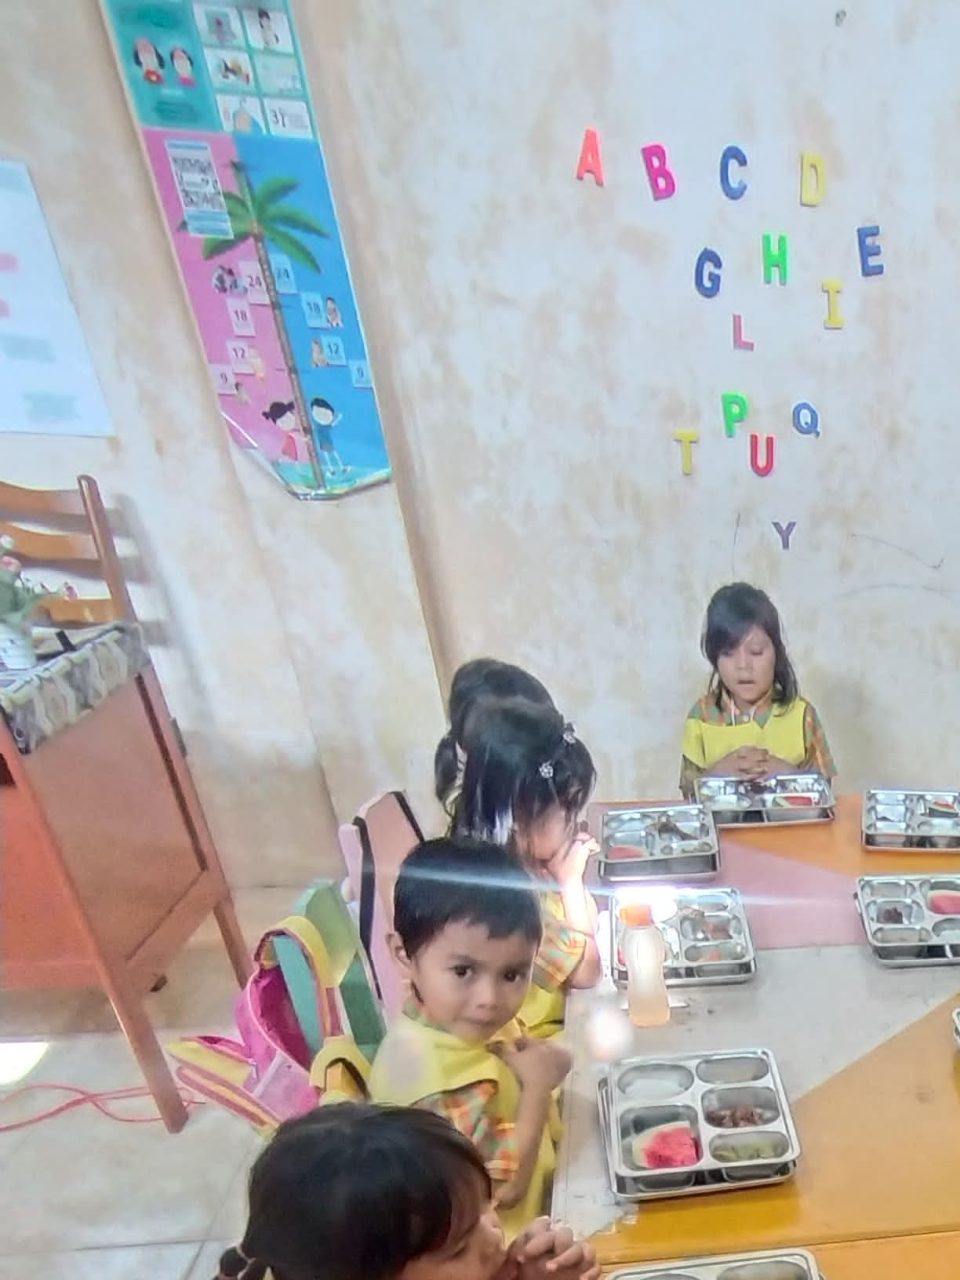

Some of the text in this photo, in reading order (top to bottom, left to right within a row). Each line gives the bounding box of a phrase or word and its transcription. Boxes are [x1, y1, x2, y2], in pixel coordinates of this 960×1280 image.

[576, 129, 826, 207] A B C D
[694, 226, 884, 298] G H E
[822, 279, 844, 329] I
[733, 314, 754, 351] L
[721, 391, 820, 438] P Q
[674, 430, 776, 476] T U
[771, 521, 797, 550] Y
